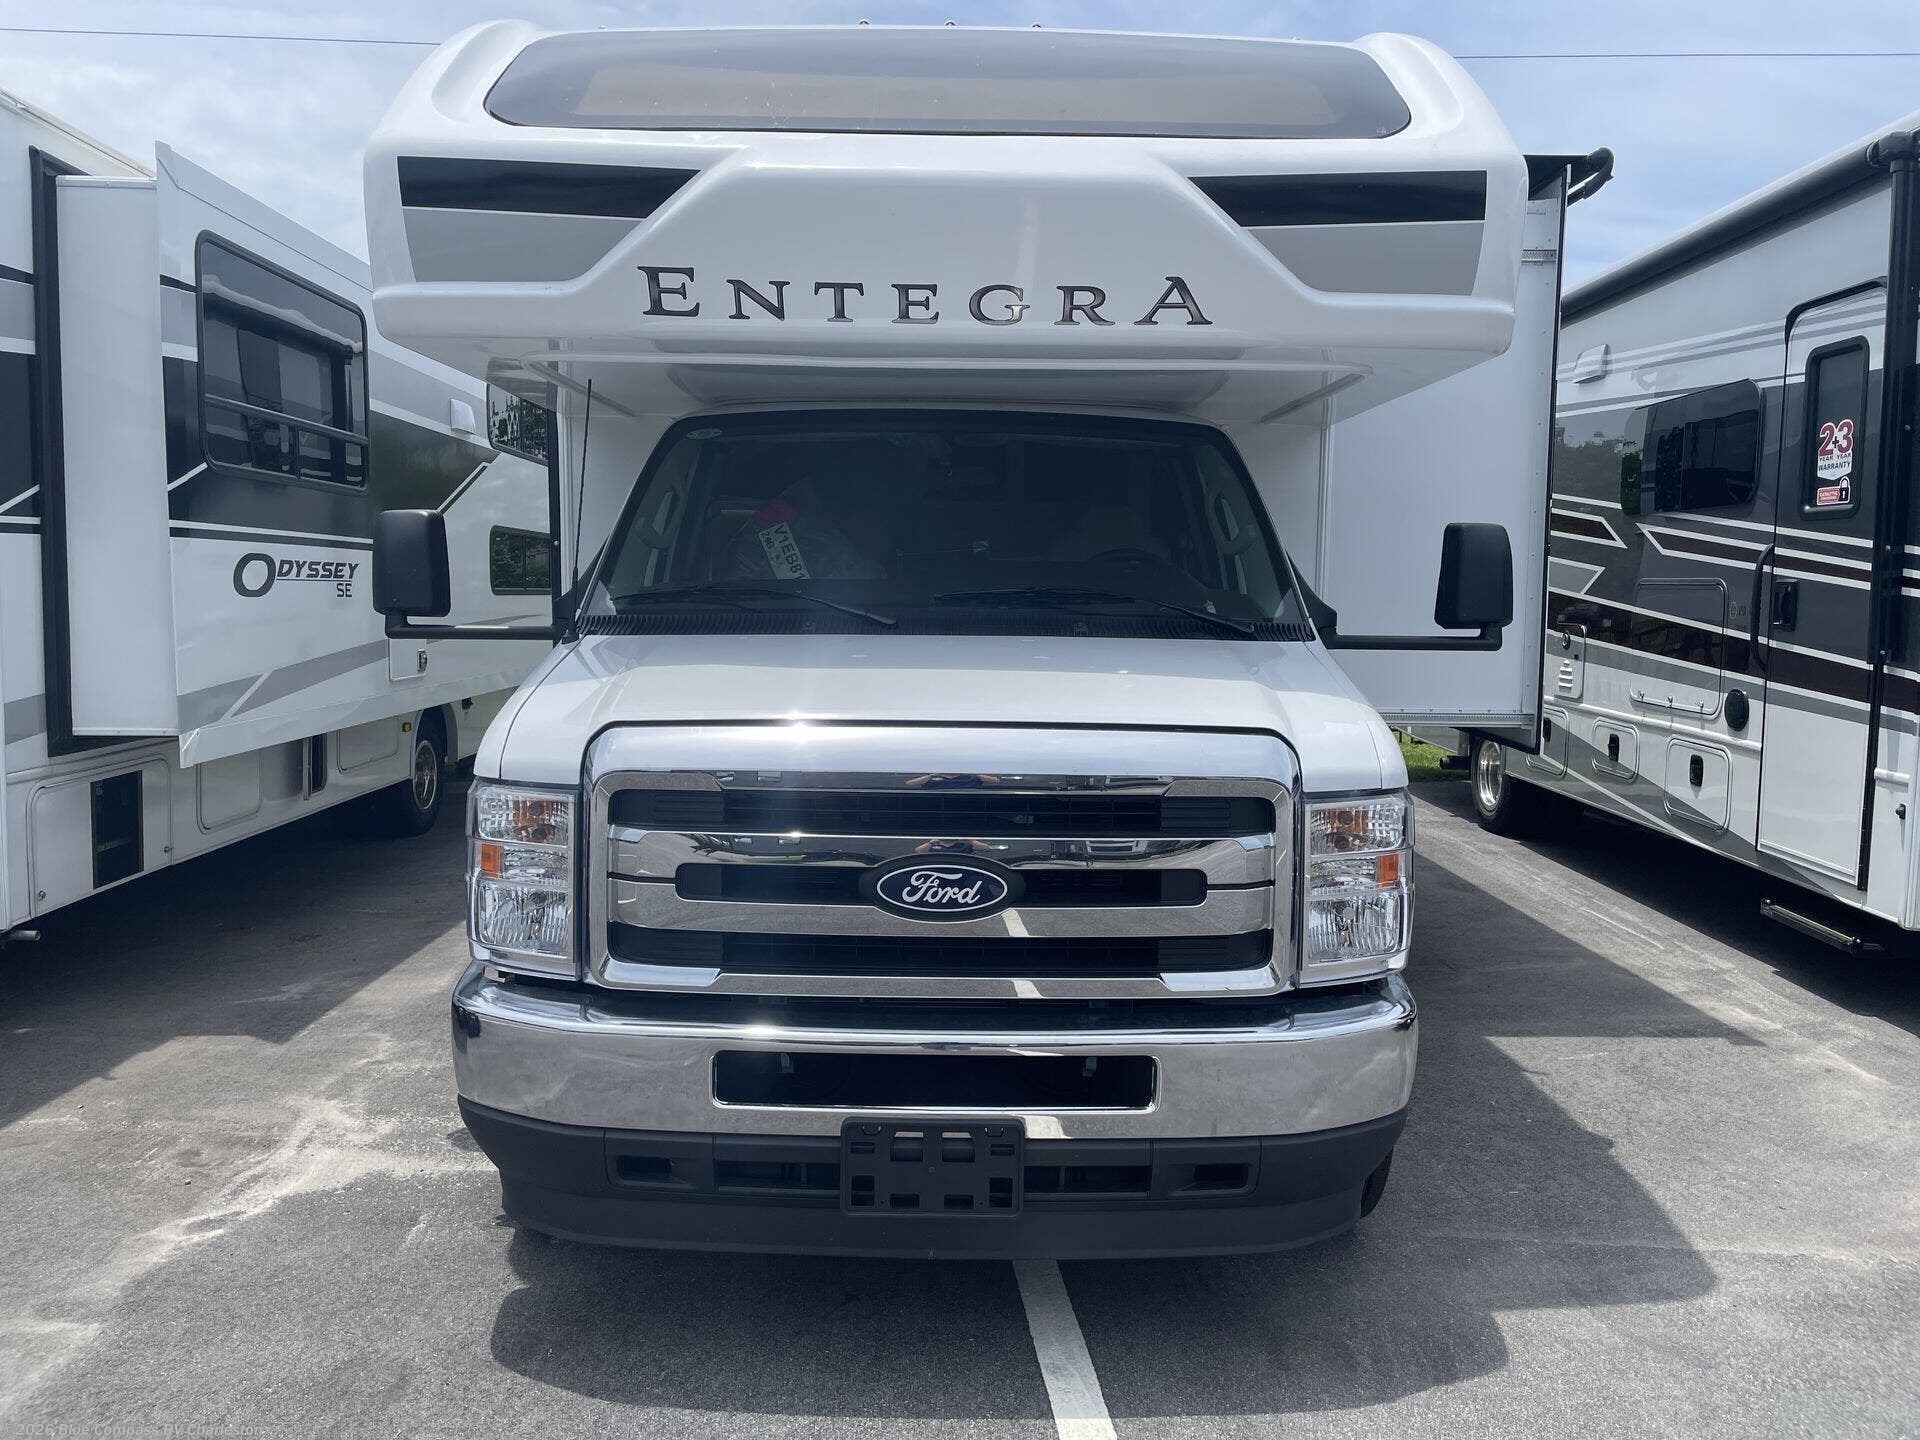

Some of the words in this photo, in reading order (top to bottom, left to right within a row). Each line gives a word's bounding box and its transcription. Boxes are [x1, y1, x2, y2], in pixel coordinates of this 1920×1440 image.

[637, 265, 1213, 326] ENTEGRA
[1818, 461, 1851, 471] WARRANTY
[233, 552, 359, 598] ODYSSEY
[336, 582, 352, 598] SE
[901, 871, 983, 904] Ford
